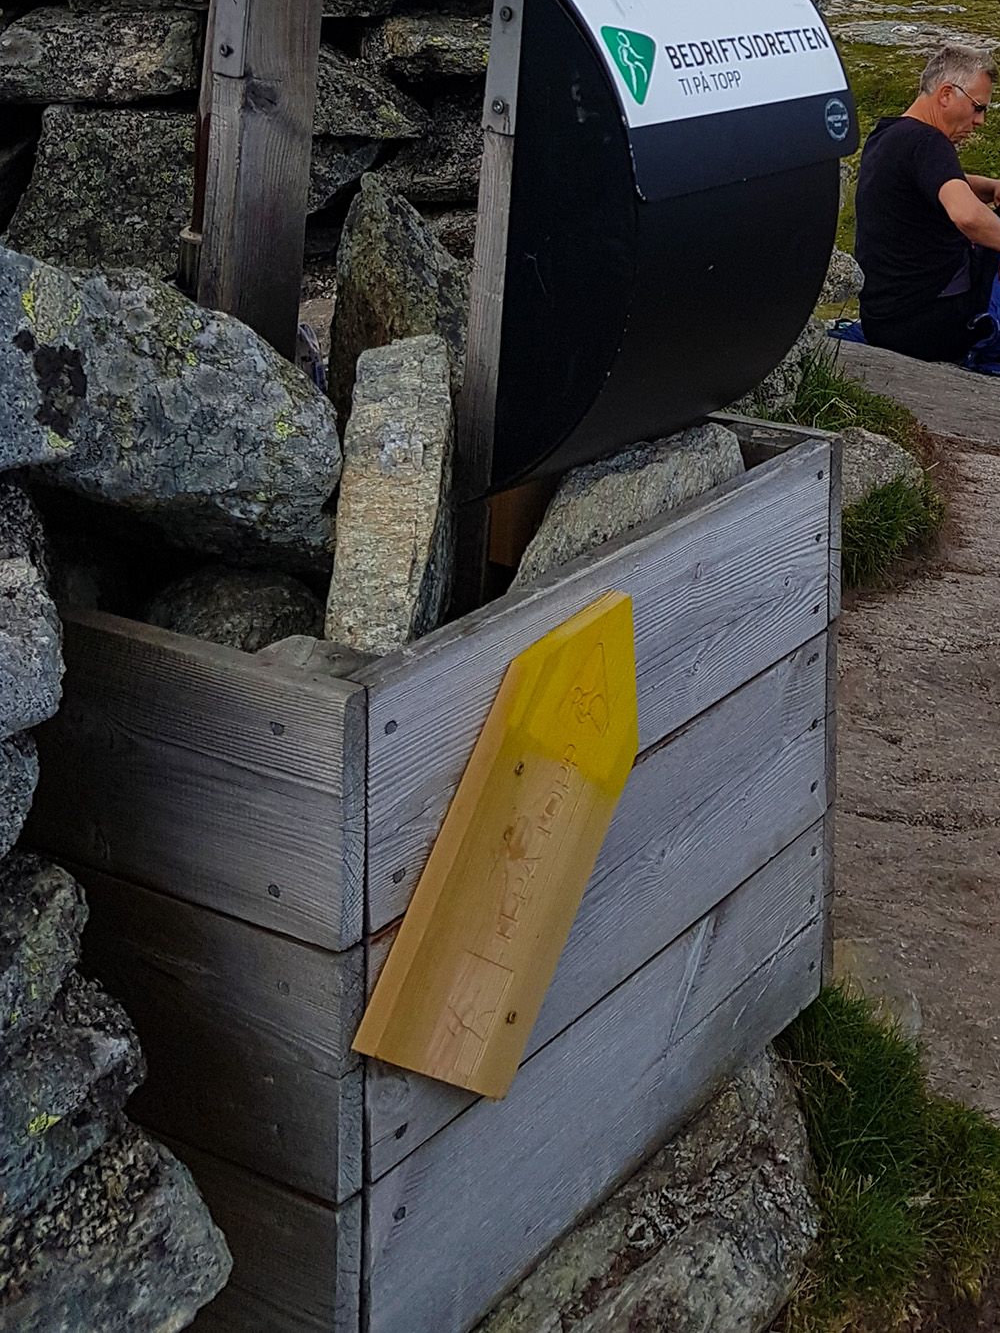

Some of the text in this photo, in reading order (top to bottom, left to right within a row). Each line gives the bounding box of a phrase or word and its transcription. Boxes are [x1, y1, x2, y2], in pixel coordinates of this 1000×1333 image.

[664, 26, 830, 70] BEDRIFTSIDRETTEN
[678, 70, 741, 96] TI PÅ TOPP
